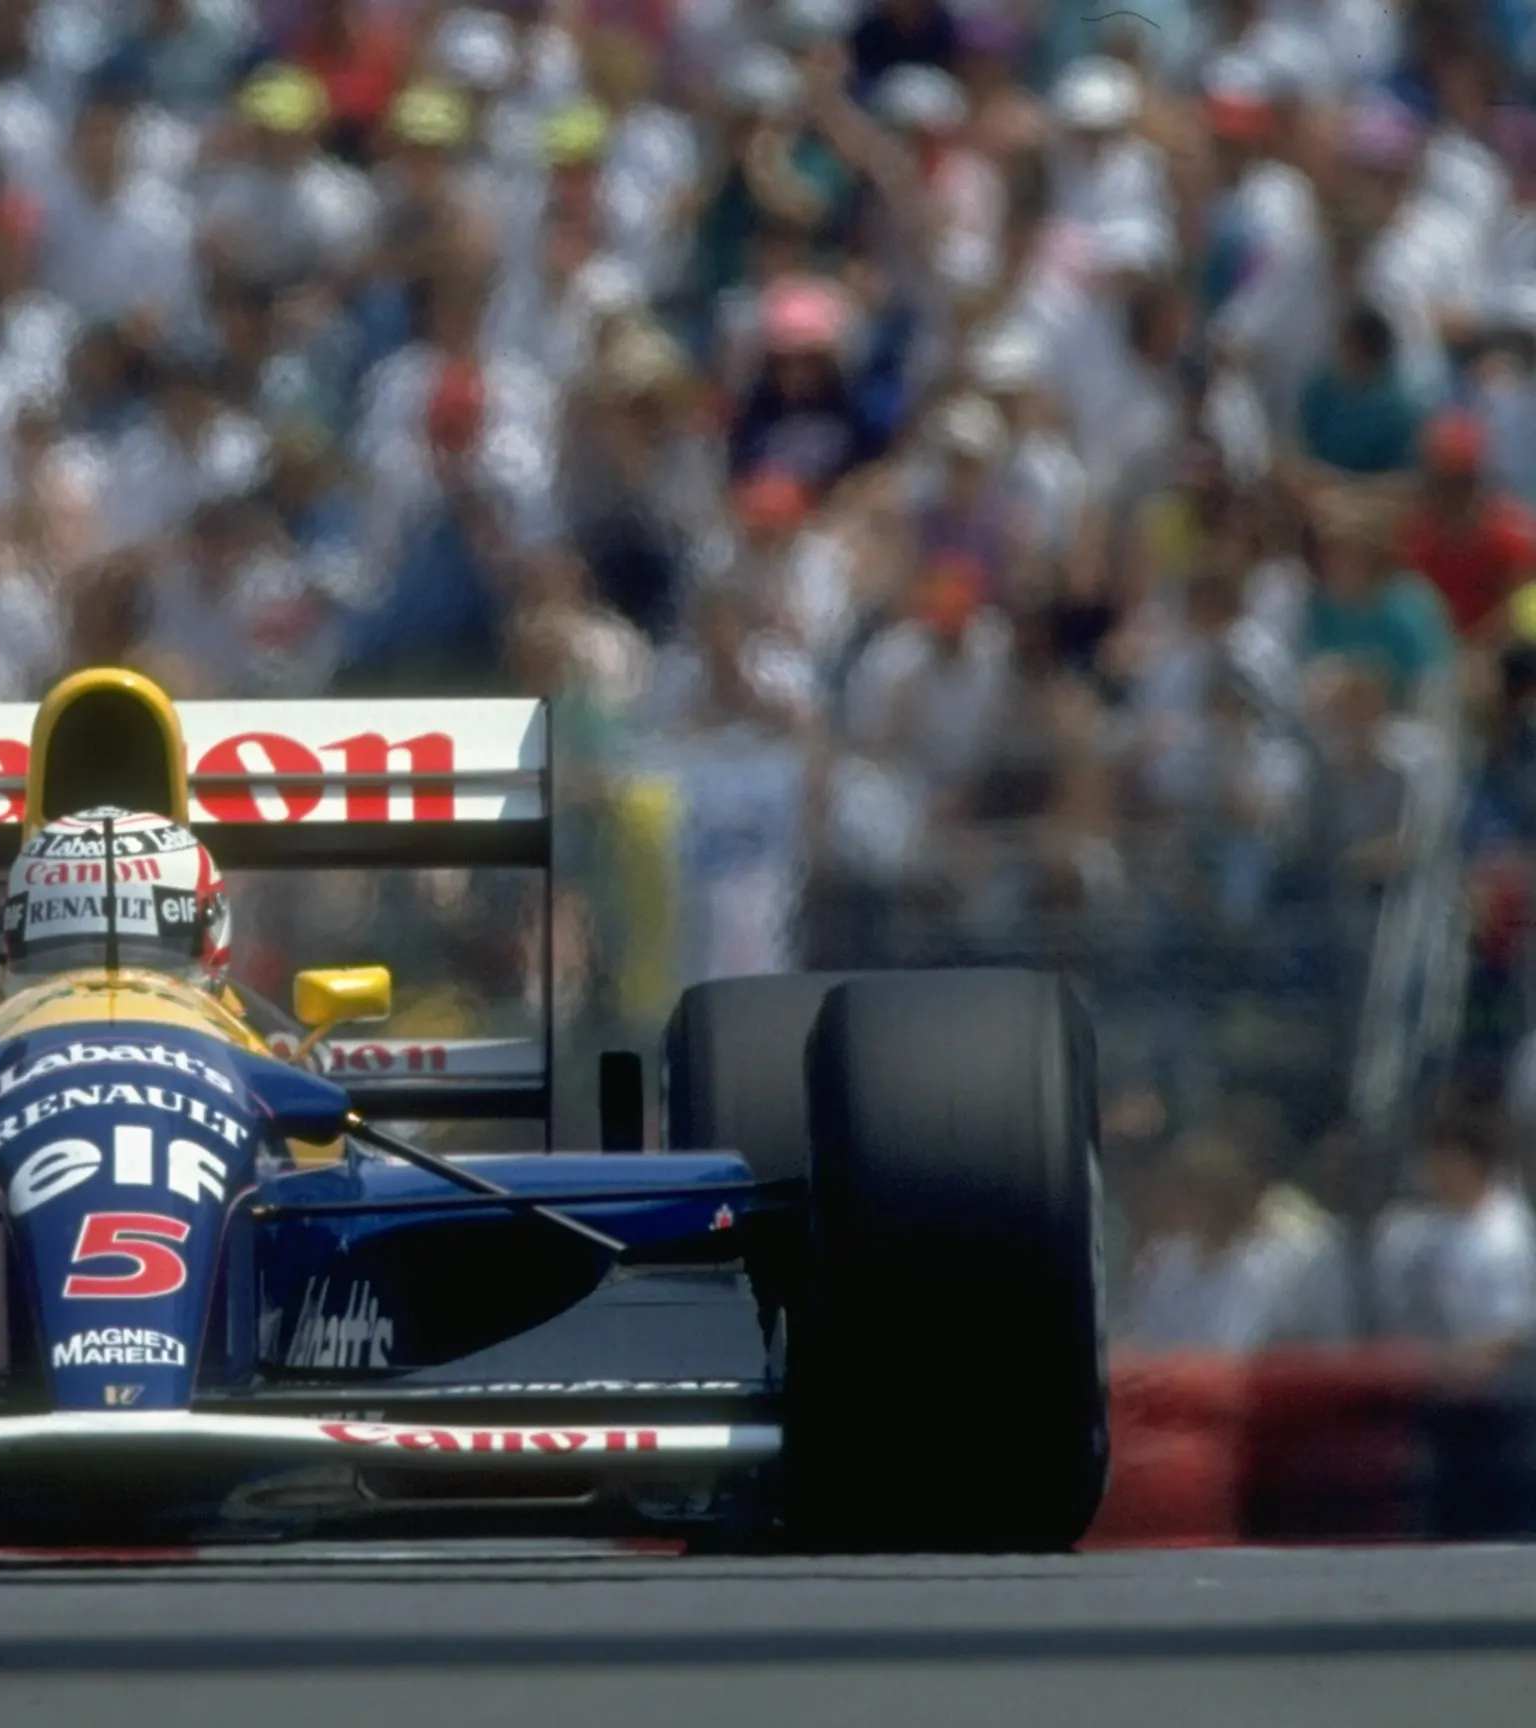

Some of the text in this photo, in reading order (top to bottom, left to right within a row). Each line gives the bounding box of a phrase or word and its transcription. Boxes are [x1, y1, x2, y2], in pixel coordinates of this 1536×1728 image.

[9, 1125, 228, 1217] elf
[62, 1211, 192, 1298] 5
[319, 1422, 658, 1455] Canon
